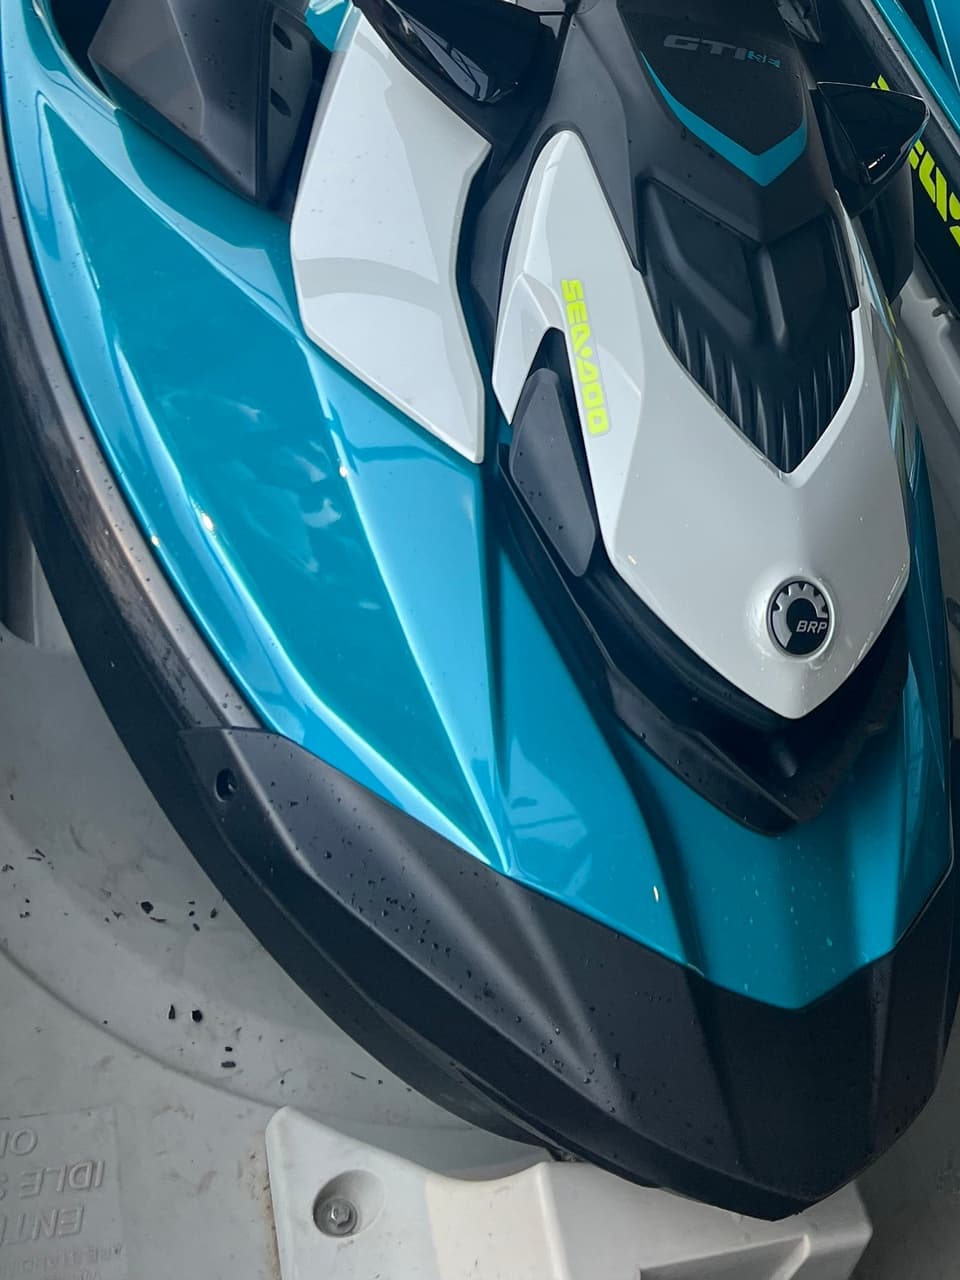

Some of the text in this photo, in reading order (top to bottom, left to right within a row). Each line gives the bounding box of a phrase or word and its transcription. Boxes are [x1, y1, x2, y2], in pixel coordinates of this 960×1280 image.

[663, 34, 747, 61] GTI
[796, 620, 828, 634] BRP
[18, 1159, 106, 1200] IDLE
